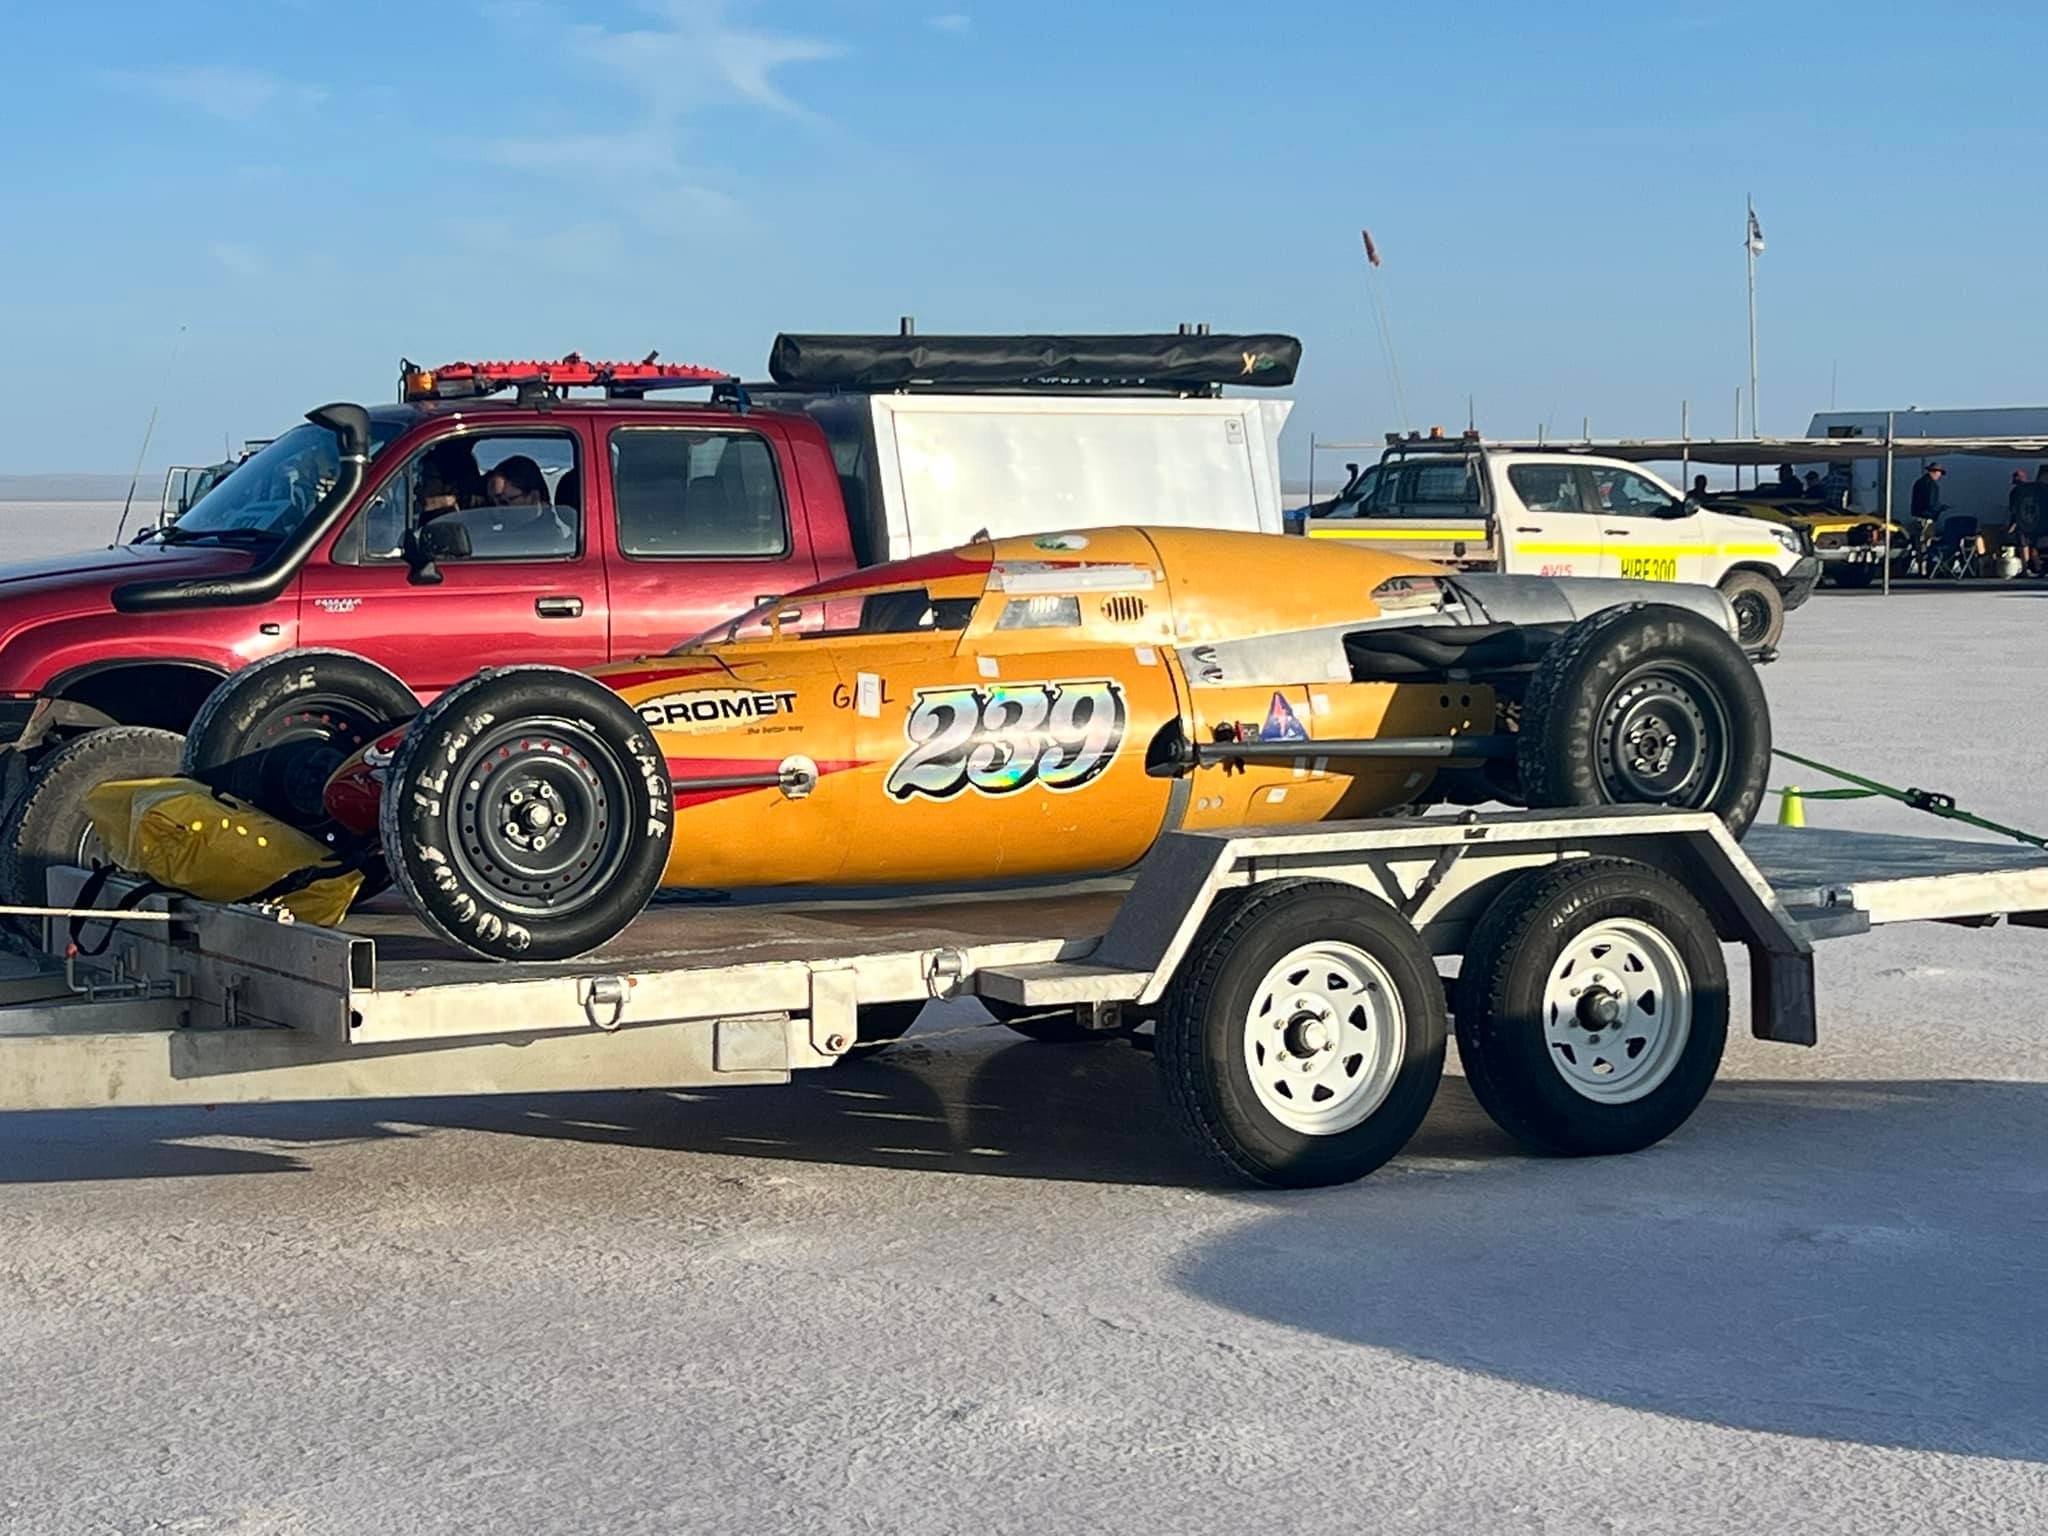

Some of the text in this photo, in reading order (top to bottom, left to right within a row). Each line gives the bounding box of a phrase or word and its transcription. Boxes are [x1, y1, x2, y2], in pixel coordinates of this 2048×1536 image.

[637, 693, 798, 727] CROMET
[886, 678, 1128, 802] 239
[624, 733, 669, 841] EAGLE
